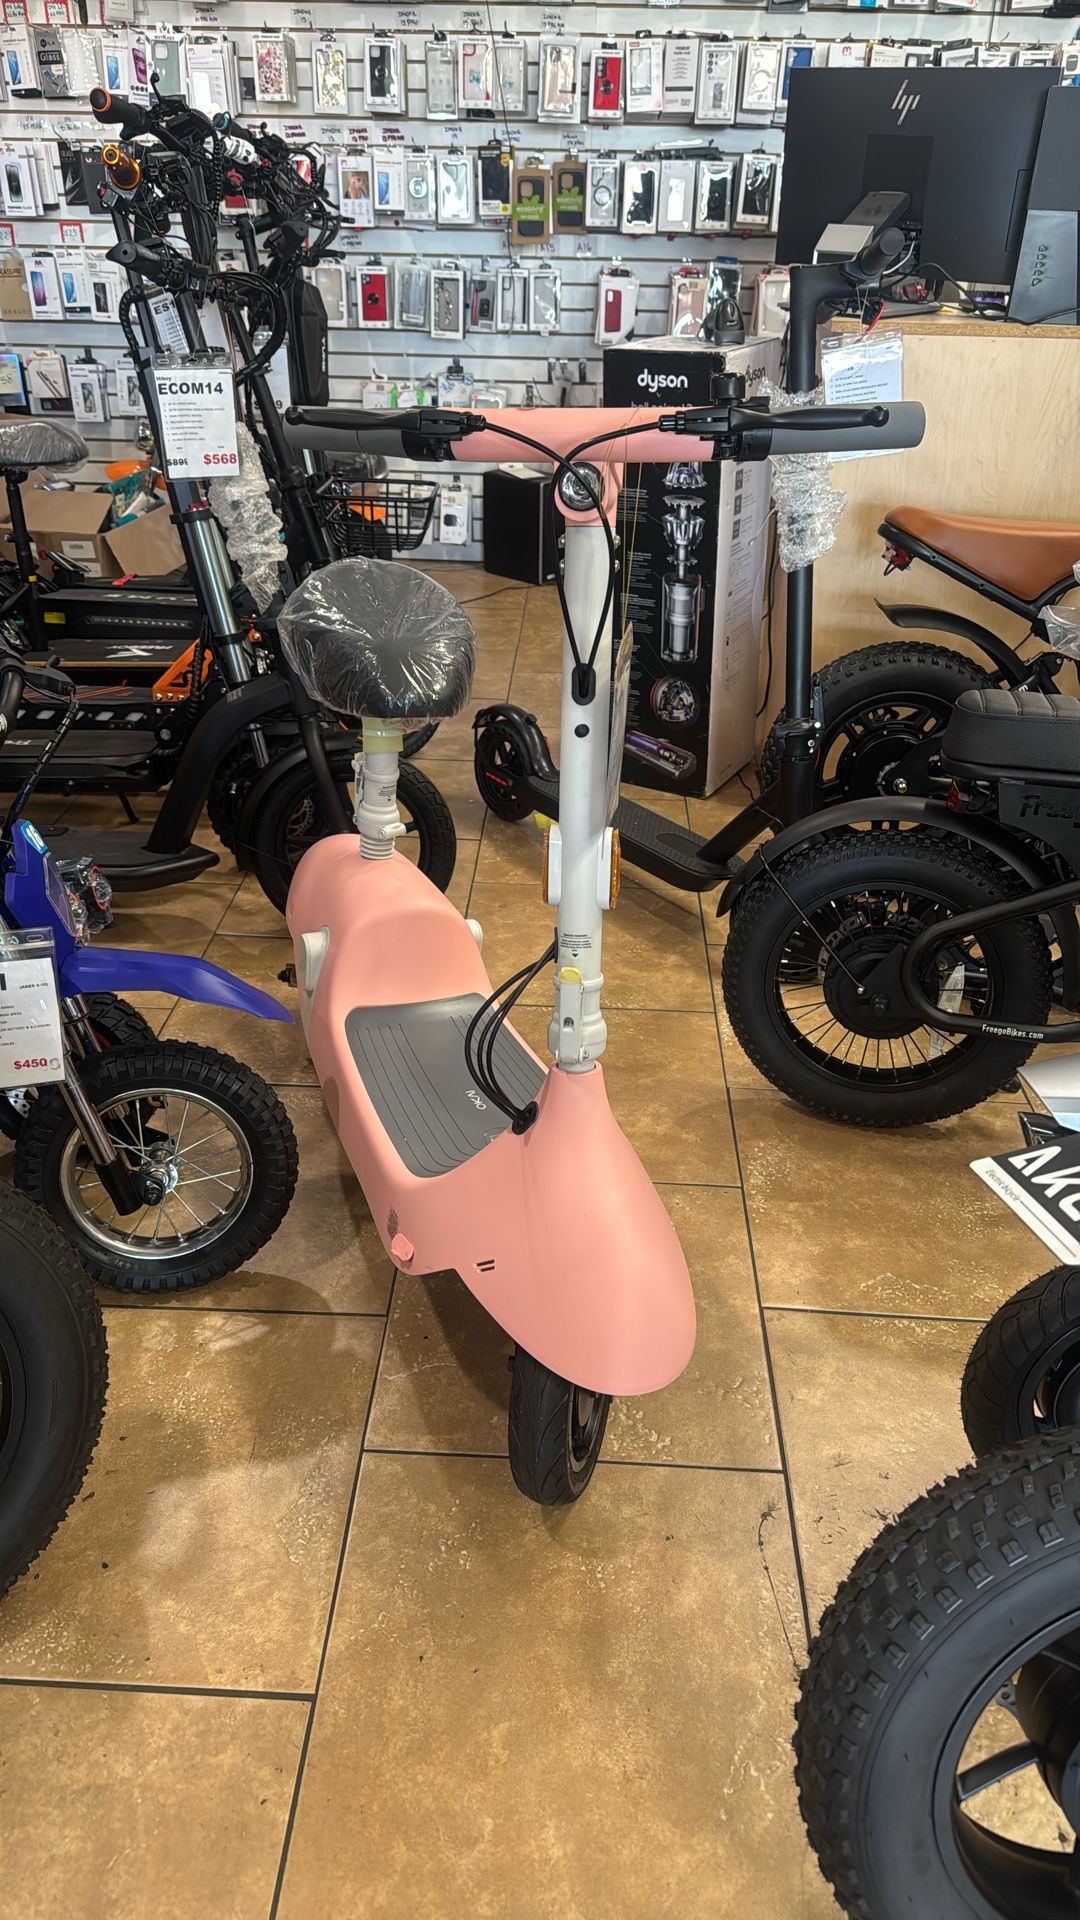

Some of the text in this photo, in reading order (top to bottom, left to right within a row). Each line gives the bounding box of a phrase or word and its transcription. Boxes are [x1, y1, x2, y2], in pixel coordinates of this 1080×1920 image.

[40, 52, 61, 61] Glass
[891, 79, 921, 125] hp
[577, 241, 592, 251] A16
[637, 368, 688, 393] dyson
[157, 382, 224, 395] ECOM14
[203, 453, 237, 465] $568
[981, 1023, 1044, 1040] FreegoBikes.com
[14, 1058, 47, 1070] $450
